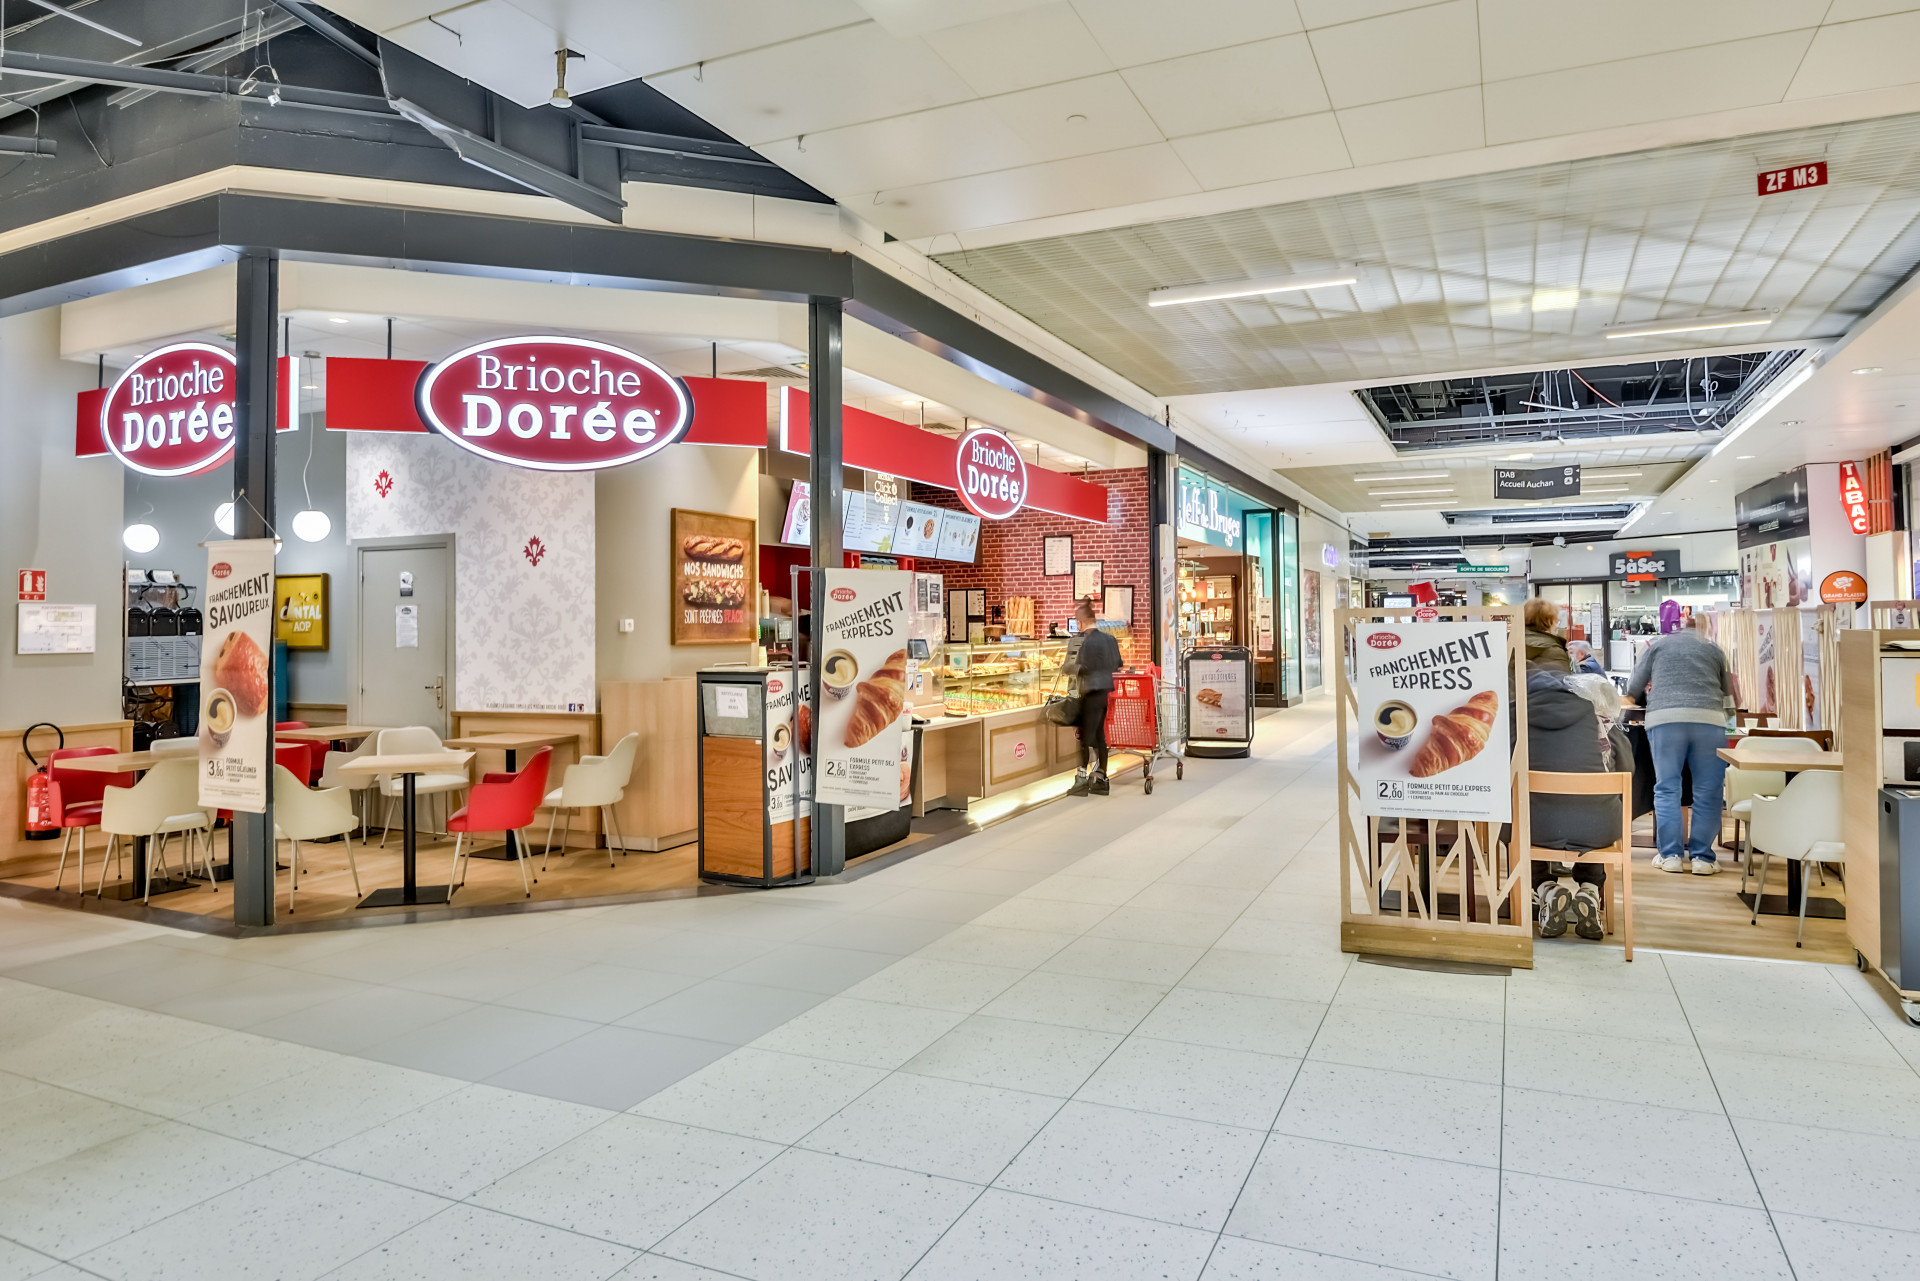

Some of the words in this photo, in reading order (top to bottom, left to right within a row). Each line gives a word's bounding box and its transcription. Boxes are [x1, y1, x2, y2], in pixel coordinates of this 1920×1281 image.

[1766, 171, 1787, 192] ZF
[1793, 166, 1818, 187] M3
[130, 361, 224, 406] Brioche
[476, 355, 641, 397] Brioche
[121, 400, 234, 453] Dorée
[462, 394, 657, 444] Dorée
[971, 438, 1016, 473] Brioche
[967, 464, 1020, 504] Dorée
[1499, 471, 1516, 479] DAB
[1499, 479, 1526, 489] Accueil
[1527, 478, 1554, 489] Auchan
[874, 480, 891, 495] Click
[874, 491, 898, 506] Collect
[1843, 463, 1867, 530] TABAC
[1177, 485, 1201, 530] Jeff
[1200, 503, 1210, 529] de
[1208, 489, 1240, 548] Bruges
[213, 569, 231, 577] Dorée
[684, 562, 701, 577] NOS
[702, 562, 744, 579] SANDWICHS
[209, 572, 270, 604] FRANCHEMENT
[832, 593, 854, 601] Dorée
[209, 597, 270, 630] SAVOUREUX
[825, 591, 904, 633] FRANCHEMENT
[293, 621, 311, 632] AOP
[841, 618, 894, 640] EXPRESS
[1372, 633, 1397, 641] Brioche
[1369, 630, 1491, 677] FRANCHEMENT
[1370, 640, 1399, 649] Dorée
[1392, 666, 1473, 691] EXPRESS
[849, 757, 871, 765] FORMULE
[871, 759, 885, 767] PETIT
[849, 763, 871, 771] EXPRESS
[1407, 782, 1434, 790] FORMULE
[1434, 783, 1450, 791] PETIT
[1464, 784, 1492, 793] EXPRESS
